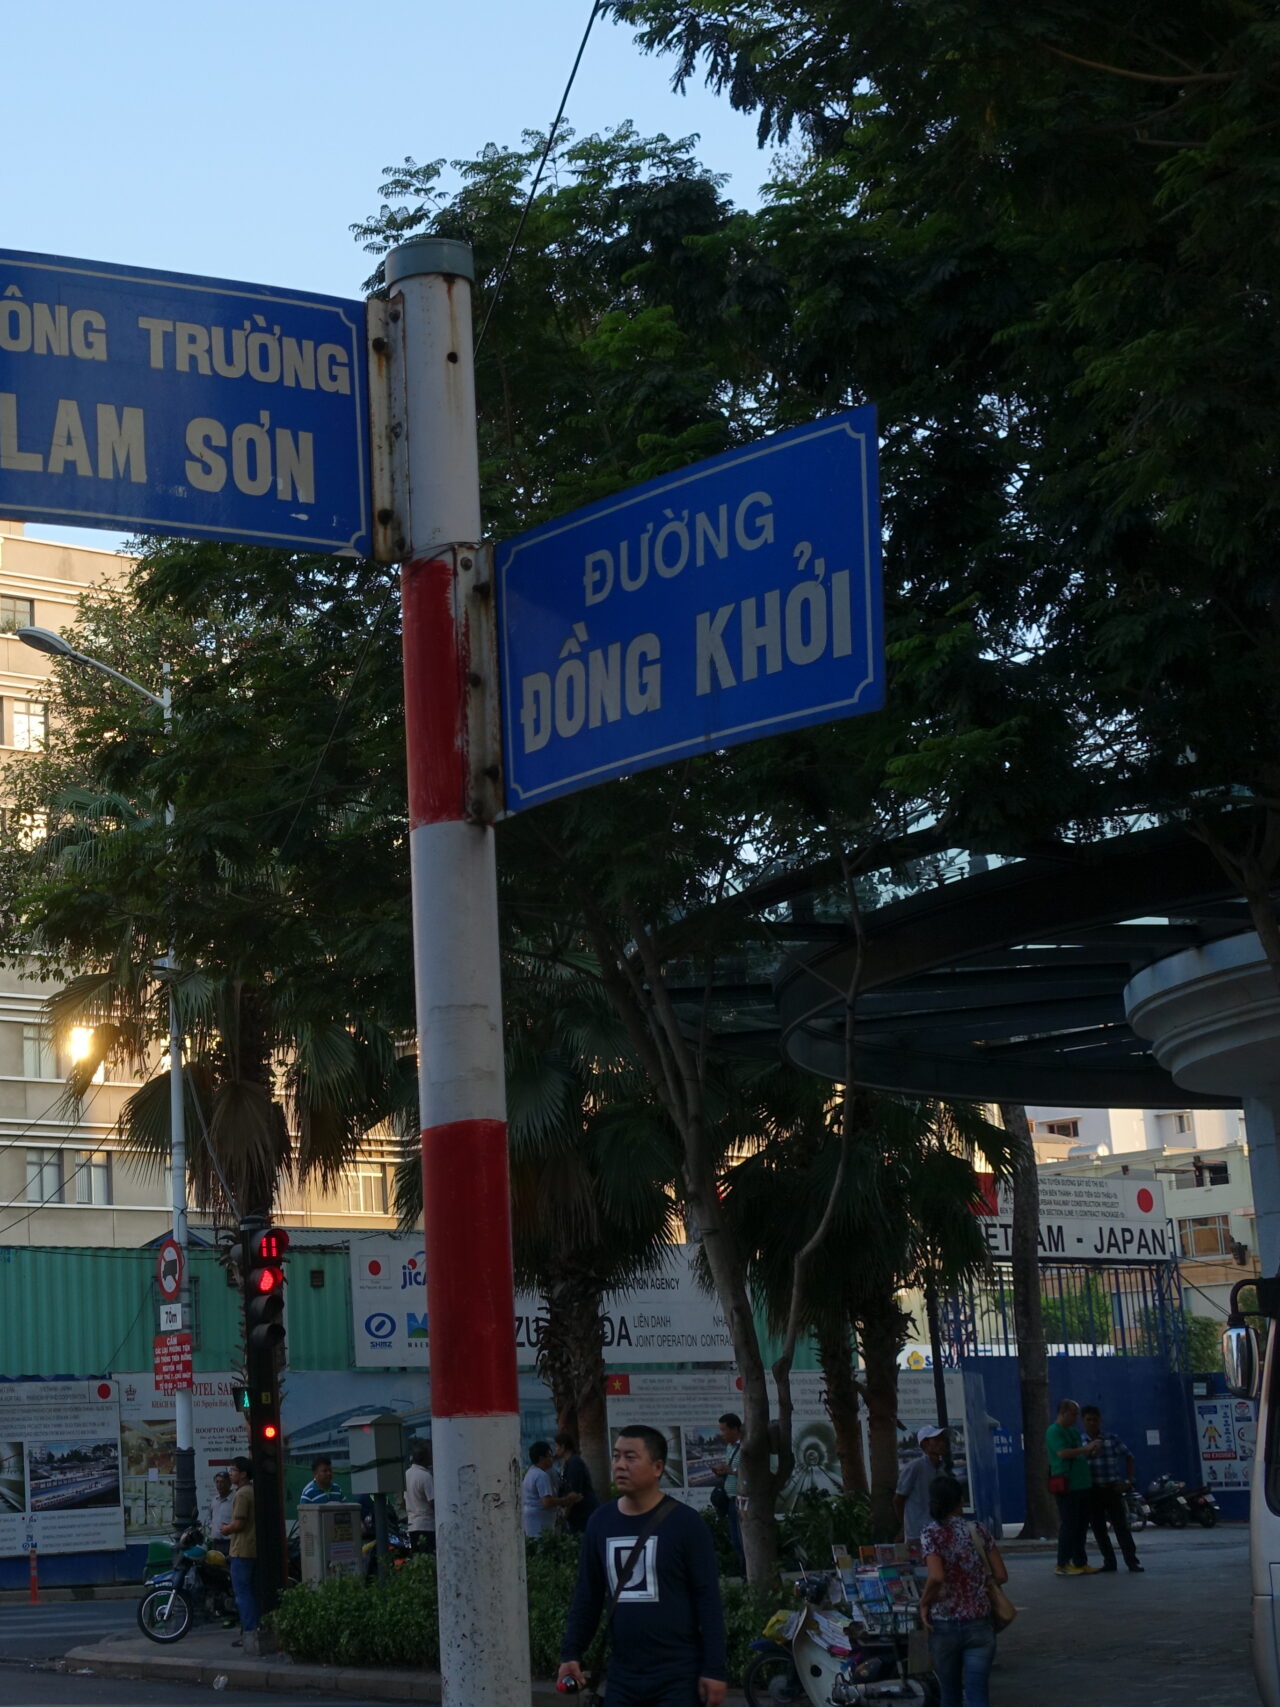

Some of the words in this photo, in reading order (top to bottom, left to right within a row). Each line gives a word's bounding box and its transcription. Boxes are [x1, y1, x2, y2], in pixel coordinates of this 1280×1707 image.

[138, 311, 352, 395] TRƯỜNG
[183, 408, 317, 505] SƠN
[582, 488, 776, 607] ĐƯỜNG
[519, 619, 663, 756] ĐỒNG
[694, 537, 856, 698] KHỞI
[1094, 1226, 1167, 1256] JAPAN
[651, 1278, 680, 1290] AGENCY
[165, 1310, 178, 1324] 70m
[651, 1315, 671, 1329] DANH
[635, 1335, 655, 1347] JOINT
[656, 1334, 697, 1347] OPERATION
[700, 1334, 734, 1347] CONTRAC
[192, 1382, 216, 1396] OTEL
